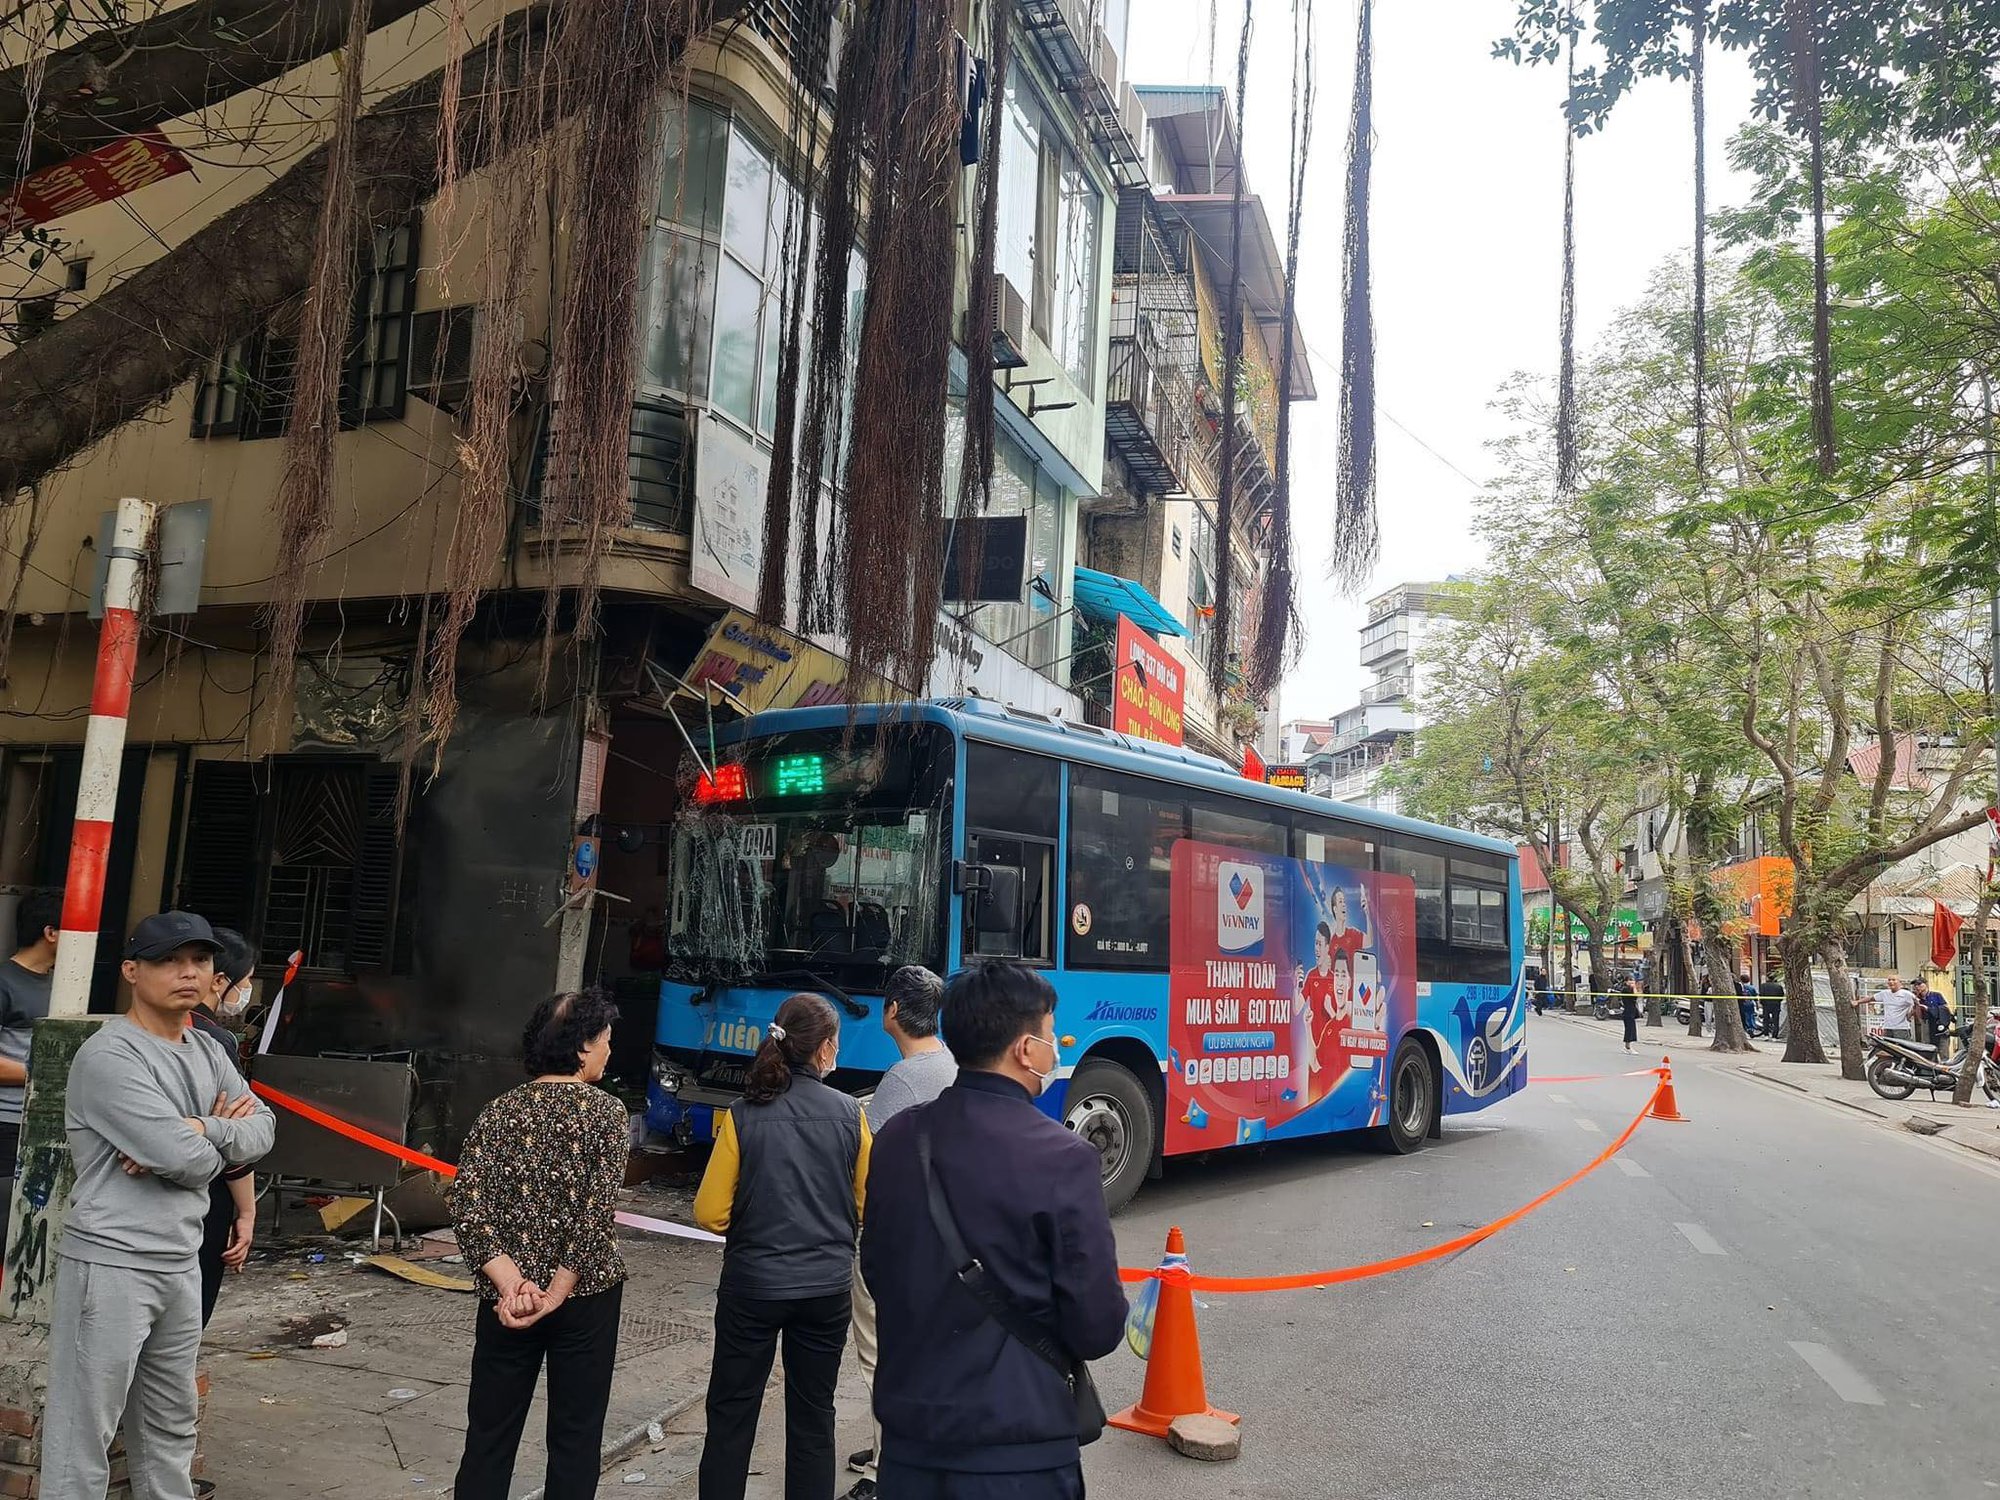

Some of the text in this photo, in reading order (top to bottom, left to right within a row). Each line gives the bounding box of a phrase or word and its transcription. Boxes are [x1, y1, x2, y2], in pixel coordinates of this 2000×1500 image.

[1121, 675, 1144, 709] CHÁO
[1149, 692, 1163, 720] BÚN
[1163, 703, 1180, 733] LÒNG
[1205, 960, 1276, 989] THANH TOÁN
[1084, 1000, 1158, 1021] HANOIBUS
[1186, 993, 1291, 1027] MUA SẮM GỌI TAXI
